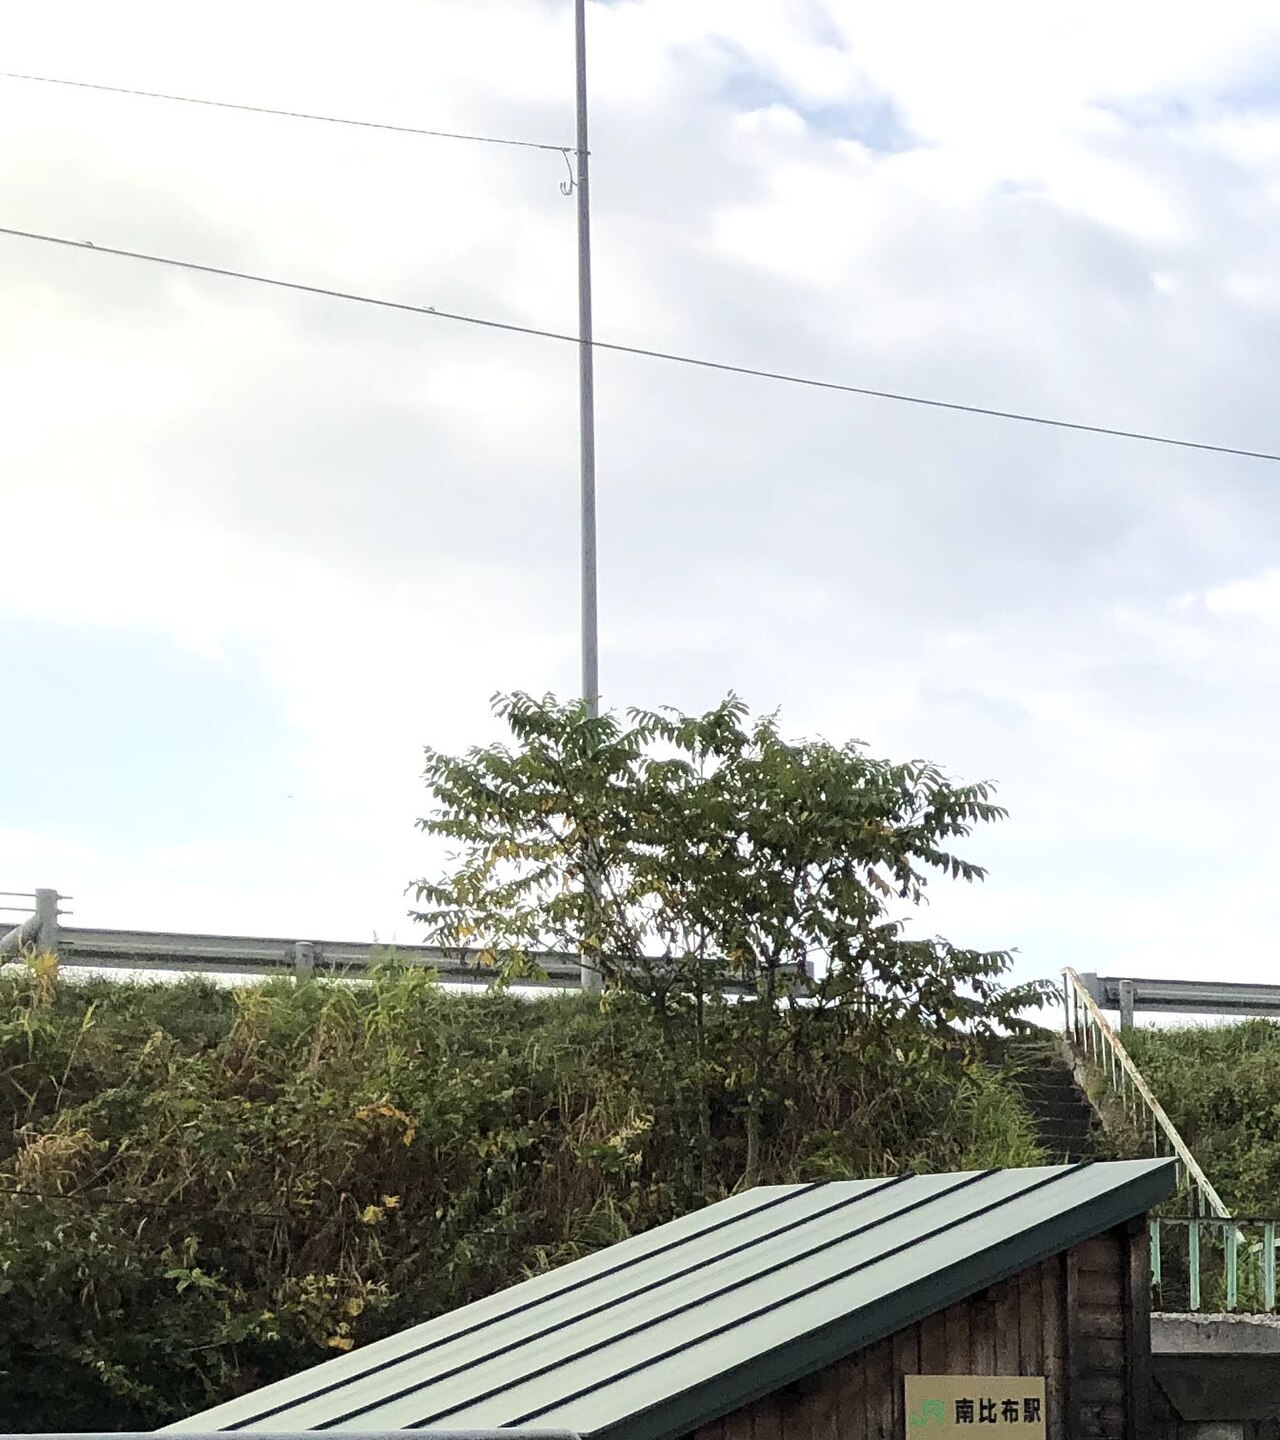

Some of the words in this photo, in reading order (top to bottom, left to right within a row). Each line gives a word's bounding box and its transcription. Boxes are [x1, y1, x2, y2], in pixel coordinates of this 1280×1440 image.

[911, 1398, 945, 1427] JR
[954, 1397, 1042, 1424] 南比布駅
